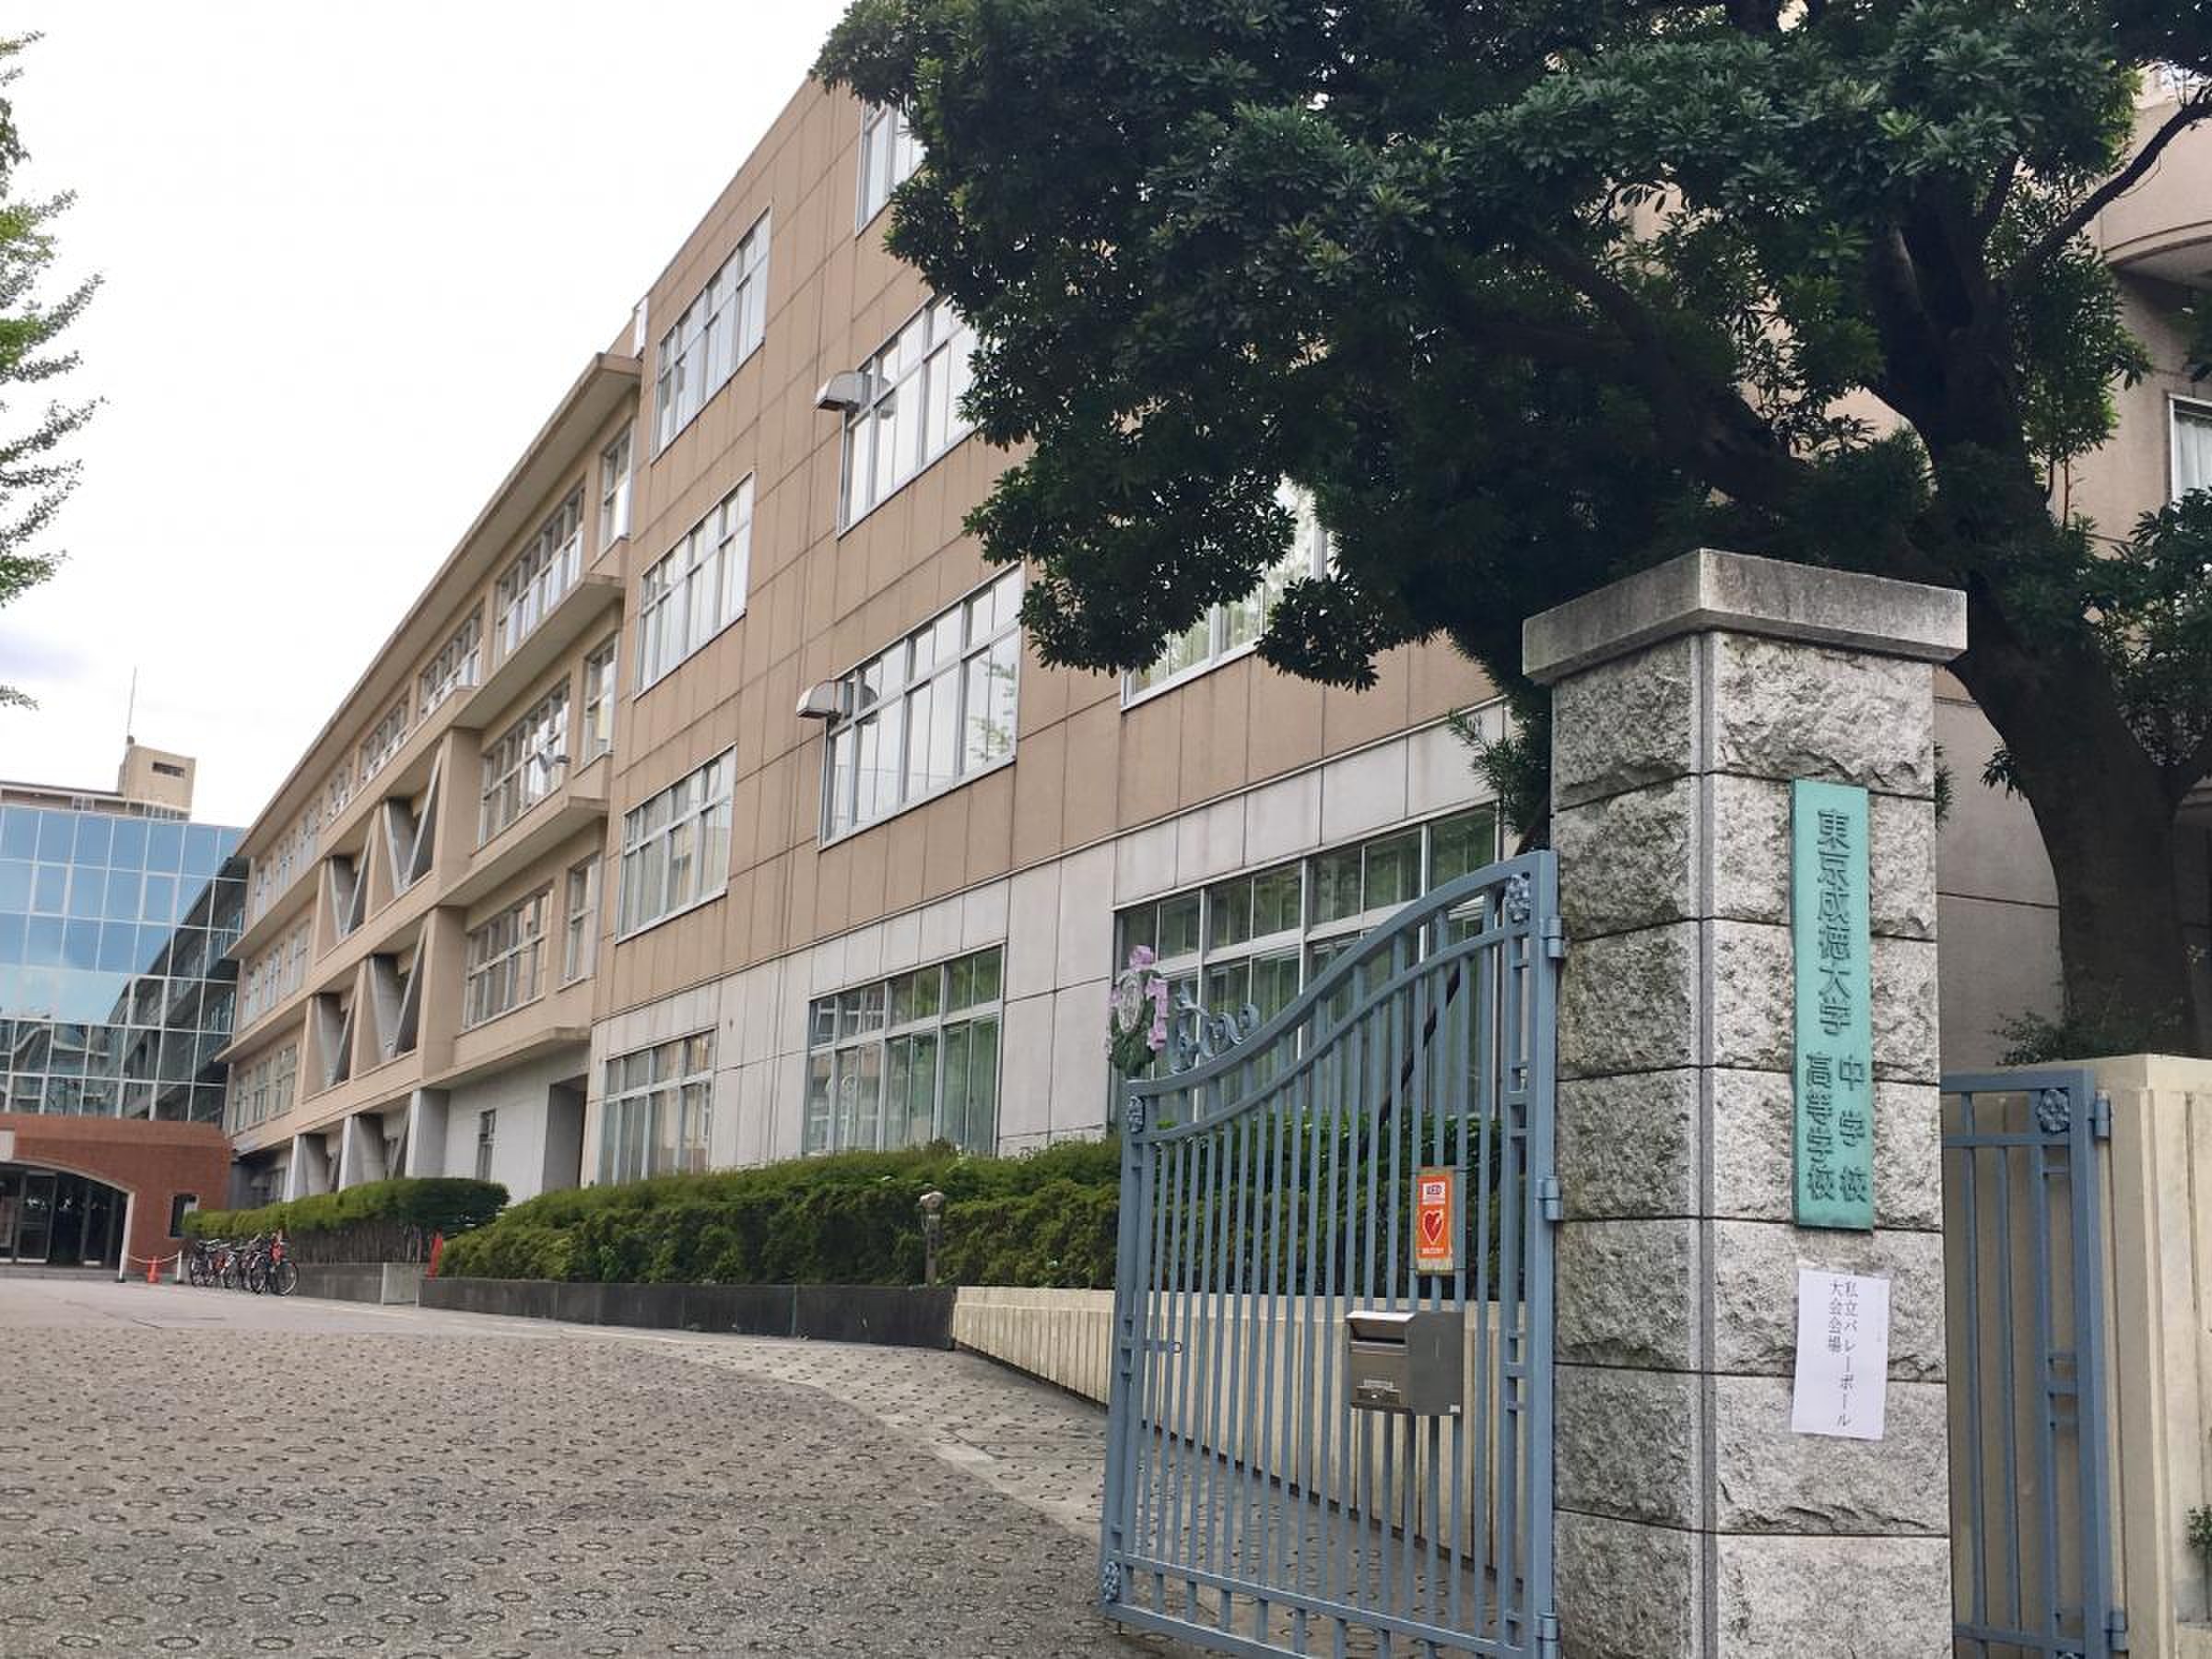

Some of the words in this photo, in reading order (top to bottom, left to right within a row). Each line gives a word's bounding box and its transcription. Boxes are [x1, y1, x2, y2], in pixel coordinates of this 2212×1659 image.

[1817, 808, 1852, 1036] 東京成徳大学
[1806, 1053, 1835, 1200] 高等学校
[1840, 1053, 1867, 1202] 中学校
